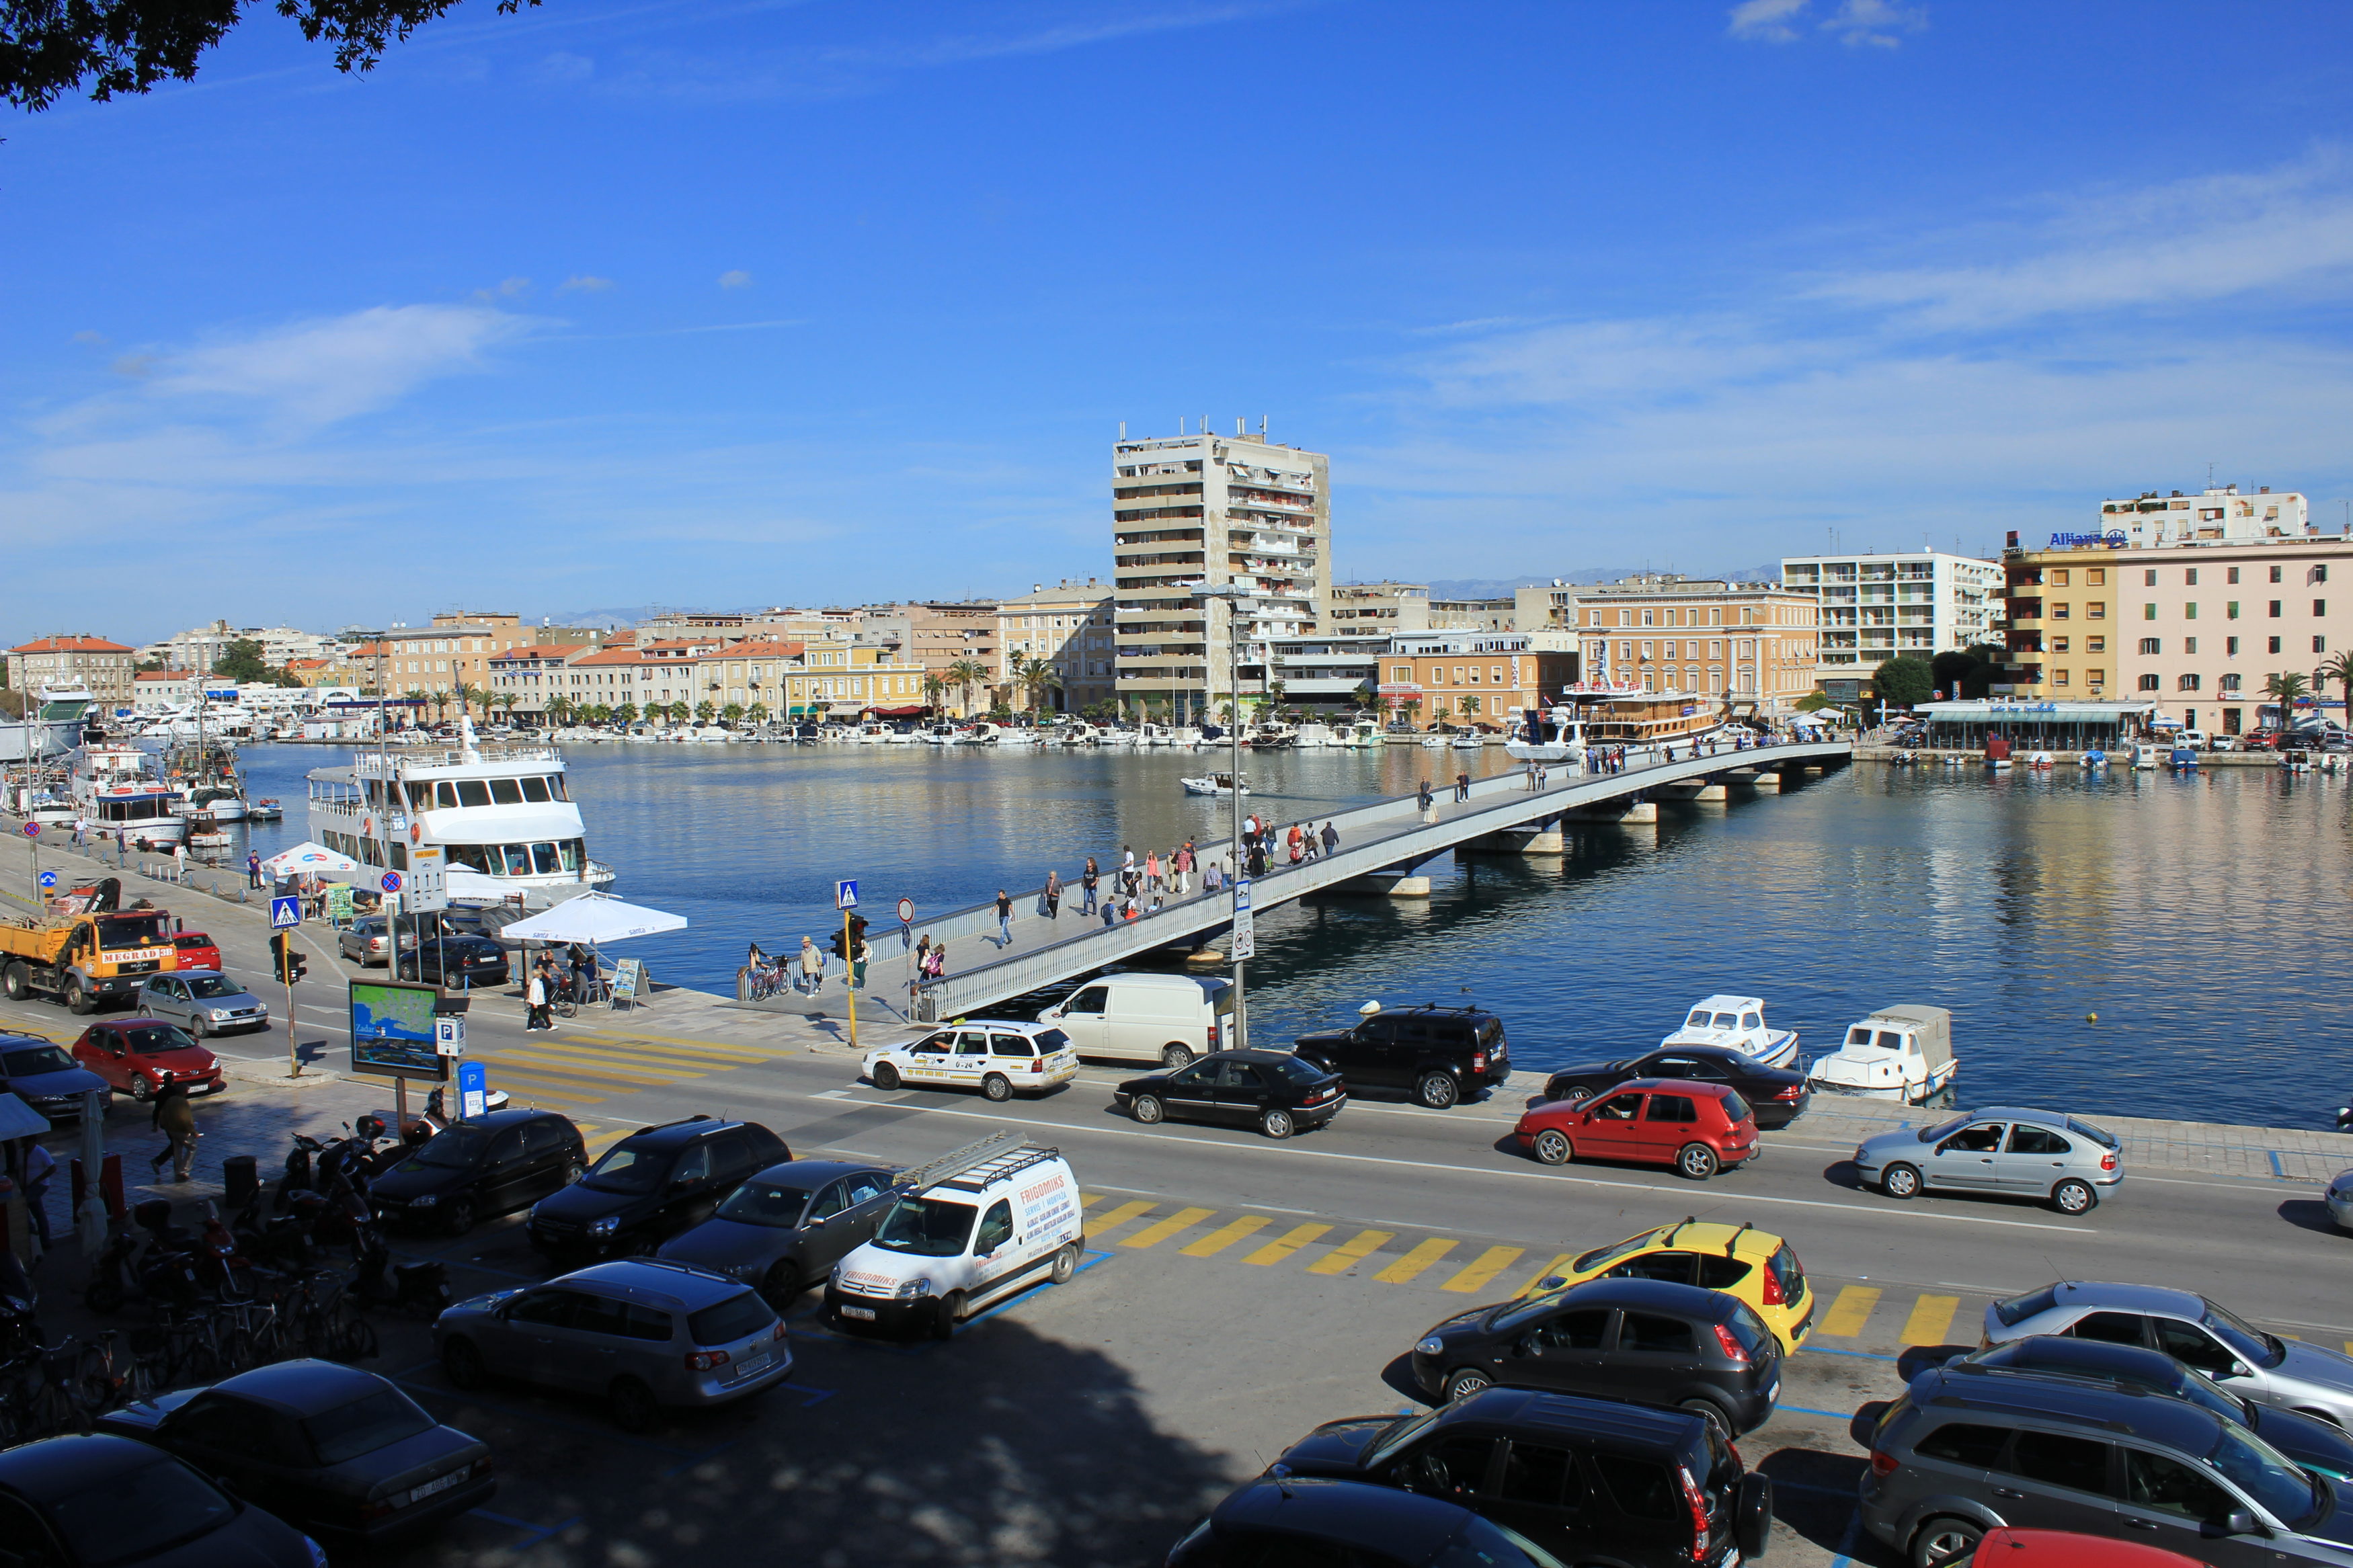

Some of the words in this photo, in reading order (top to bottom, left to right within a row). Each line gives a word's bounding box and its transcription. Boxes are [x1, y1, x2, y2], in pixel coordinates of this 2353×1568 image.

[2050, 532, 2102, 546] Allianz
[393, 821, 405, 830] 10
[629, 927, 646, 936] santa
[104, 950, 157, 962] MEGRAD
[160, 948, 173, 956] 3B
[356, 1024, 374, 1033] Zadar
[443, 1026, 451, 1038] P
[469, 1074, 477, 1085] P
[1019, 1174, 1065, 1205] FRIGOMIKS
[1025, 1202, 1041, 1216] SERVIS
[1043, 1241, 1054, 1251] SERVIS
[844, 1270, 898, 1286] FRIGOMIKS
[416, 1487, 426, 1499] ZD
[431, 1473, 457, 1491] 486-AH
